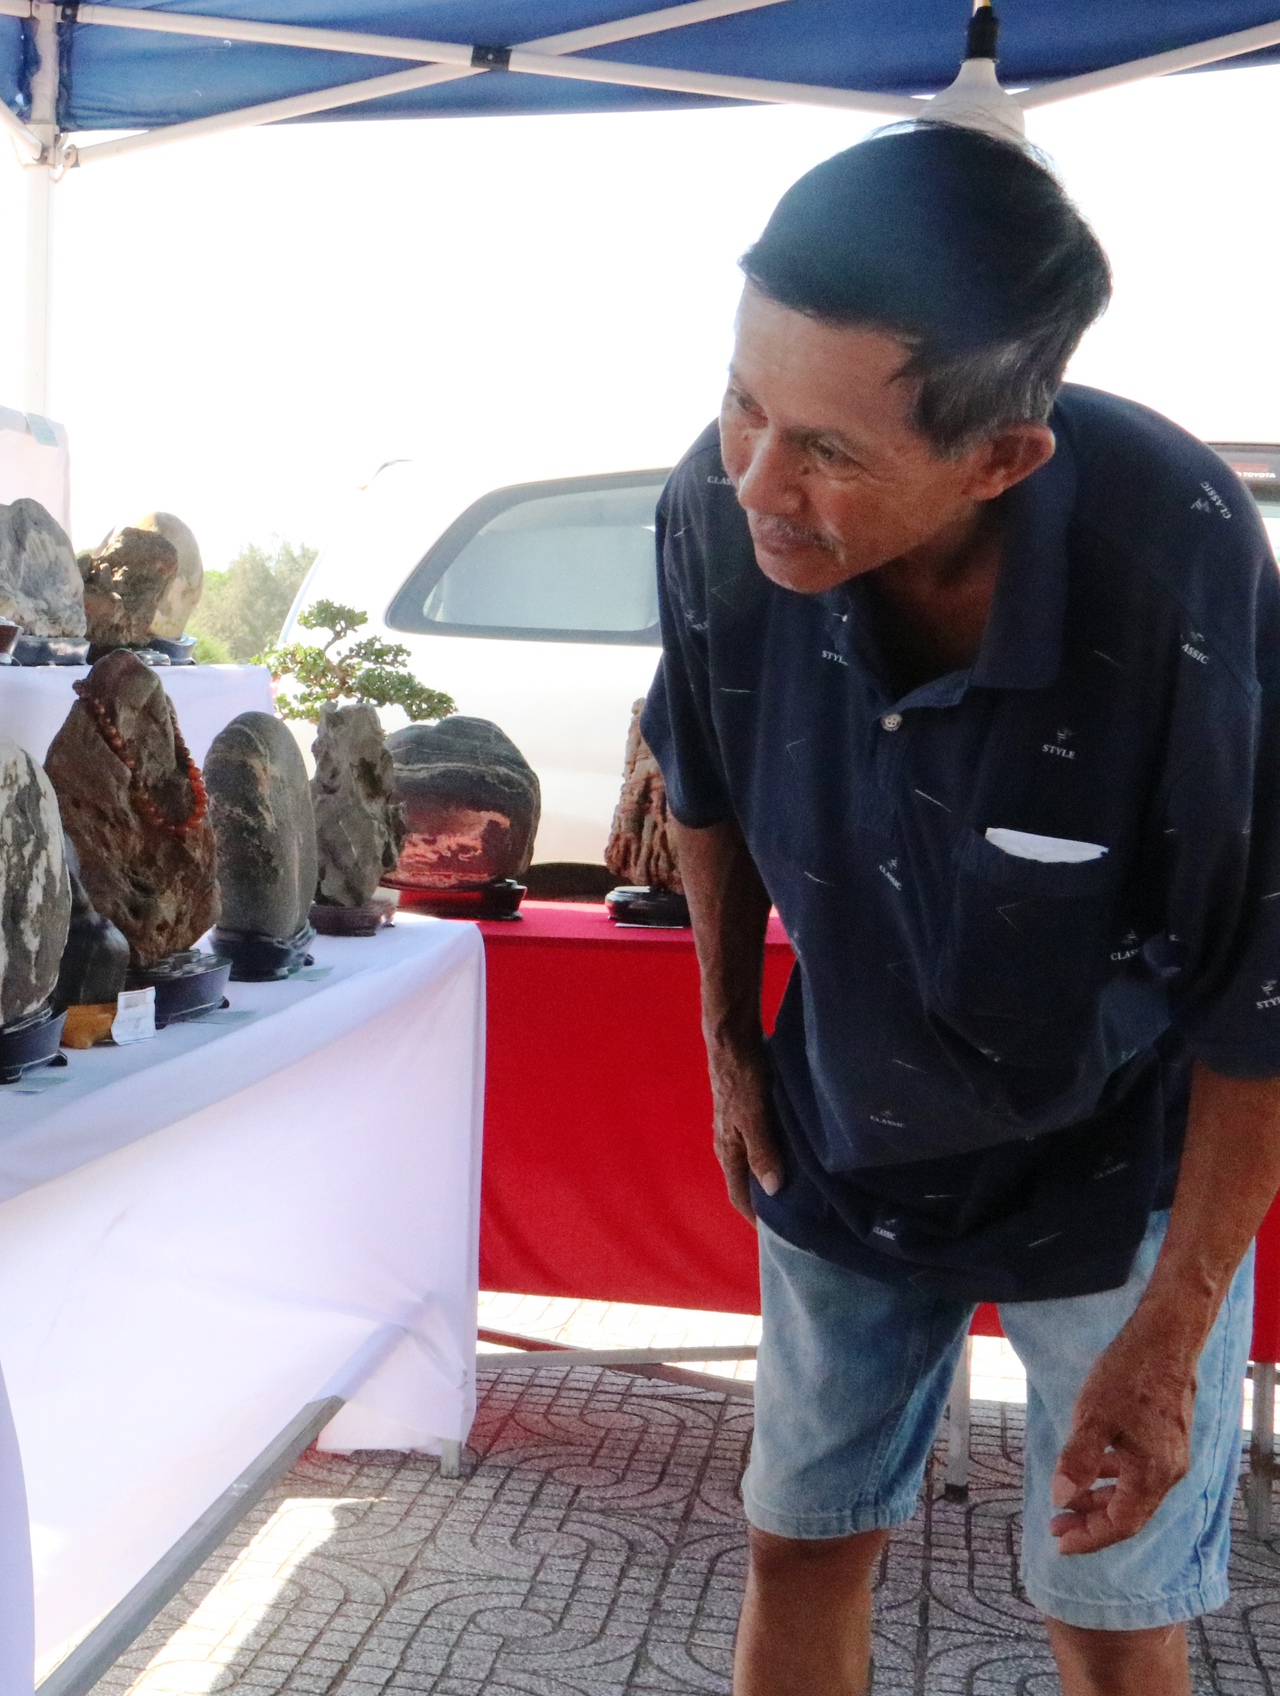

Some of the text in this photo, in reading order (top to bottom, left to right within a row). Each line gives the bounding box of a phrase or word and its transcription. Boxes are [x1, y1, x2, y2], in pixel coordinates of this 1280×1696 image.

[707, 475, 732, 485] CLAS
[1200, 481, 1232, 519] CLASSIC
[822, 650, 848, 666] STYL
[1181, 643, 1209, 664] ASSIC
[1042, 744, 1075, 760] STYLE
[870, 1115, 906, 1128] CLASSIC
